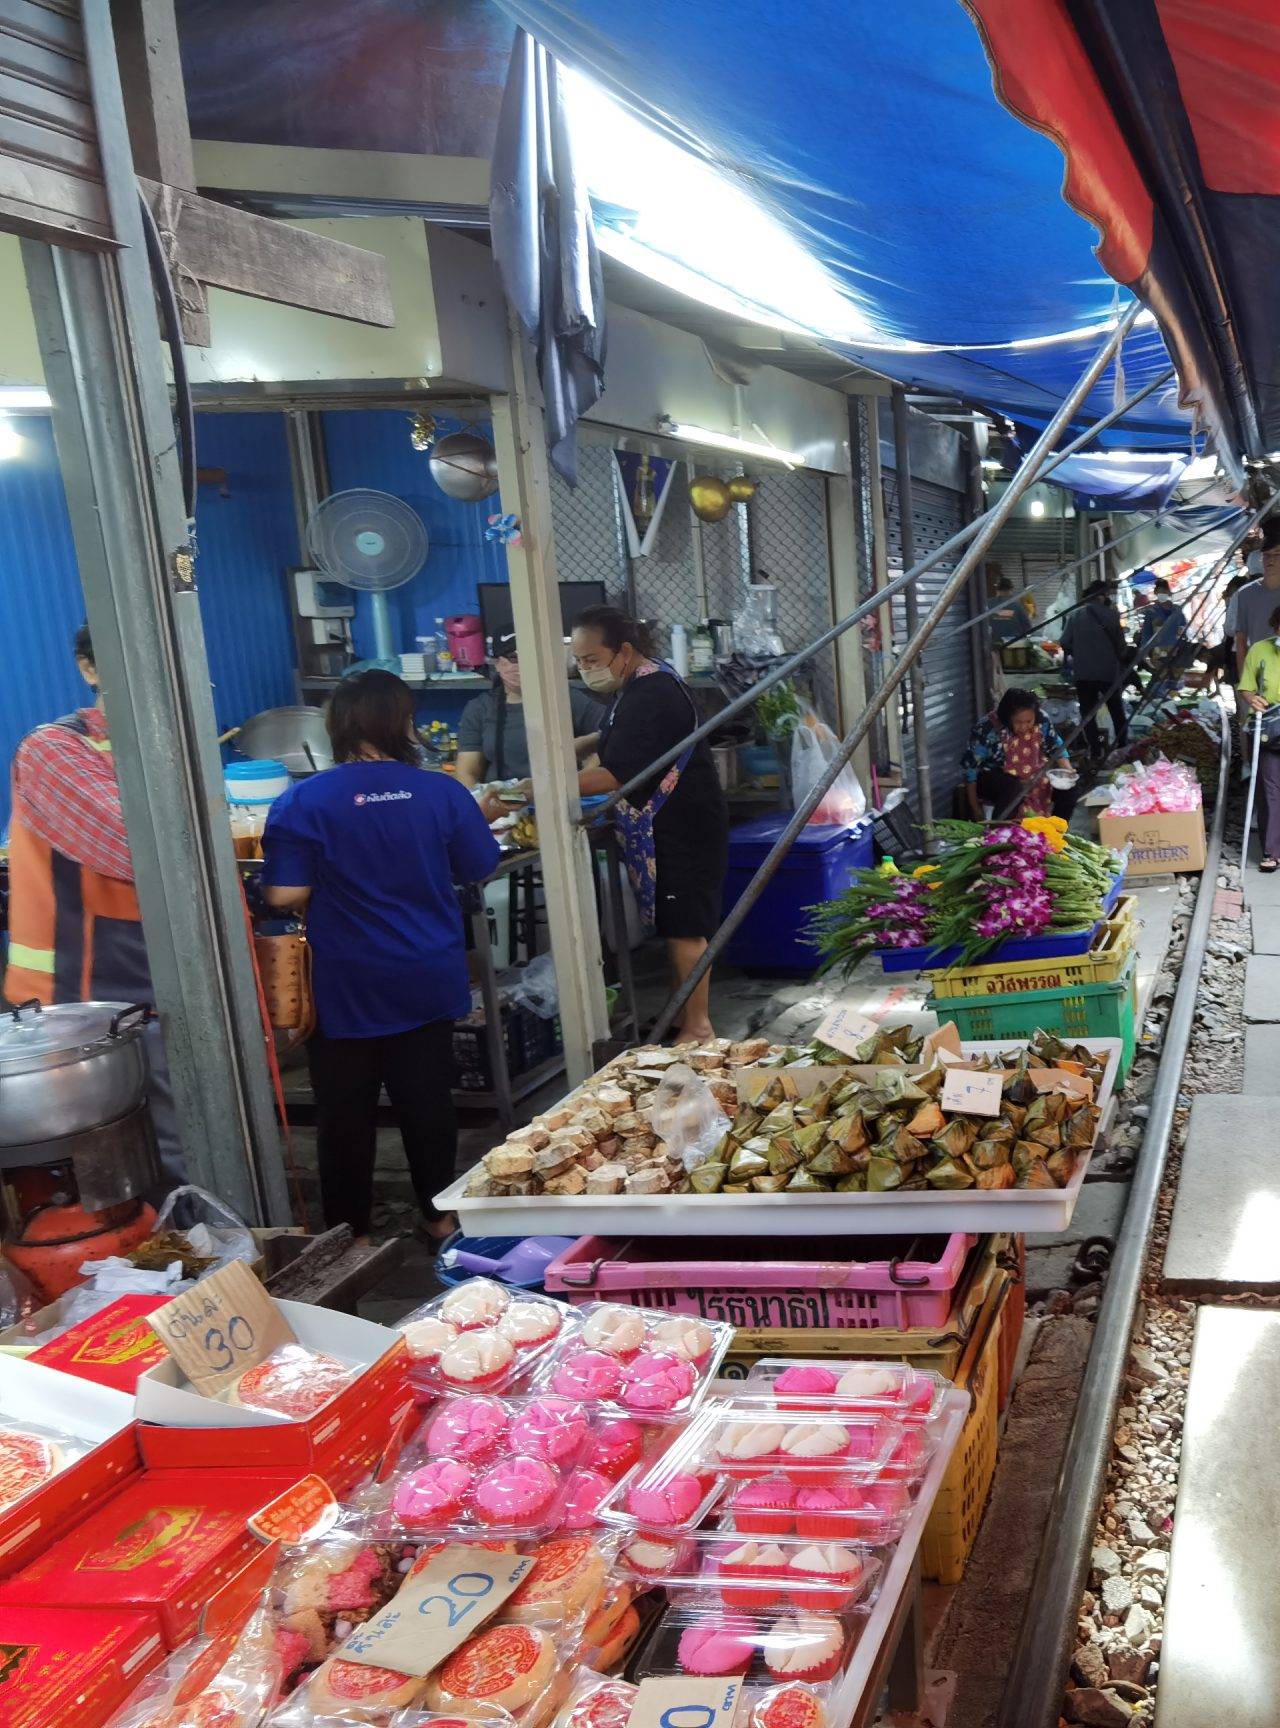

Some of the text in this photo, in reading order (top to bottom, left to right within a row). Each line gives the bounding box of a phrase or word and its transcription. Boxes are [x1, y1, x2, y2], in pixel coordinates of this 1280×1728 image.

[1127, 844, 1190, 860] ORTHERN
[205, 1316, 254, 1371] 30
[418, 1572, 494, 1627] 20
